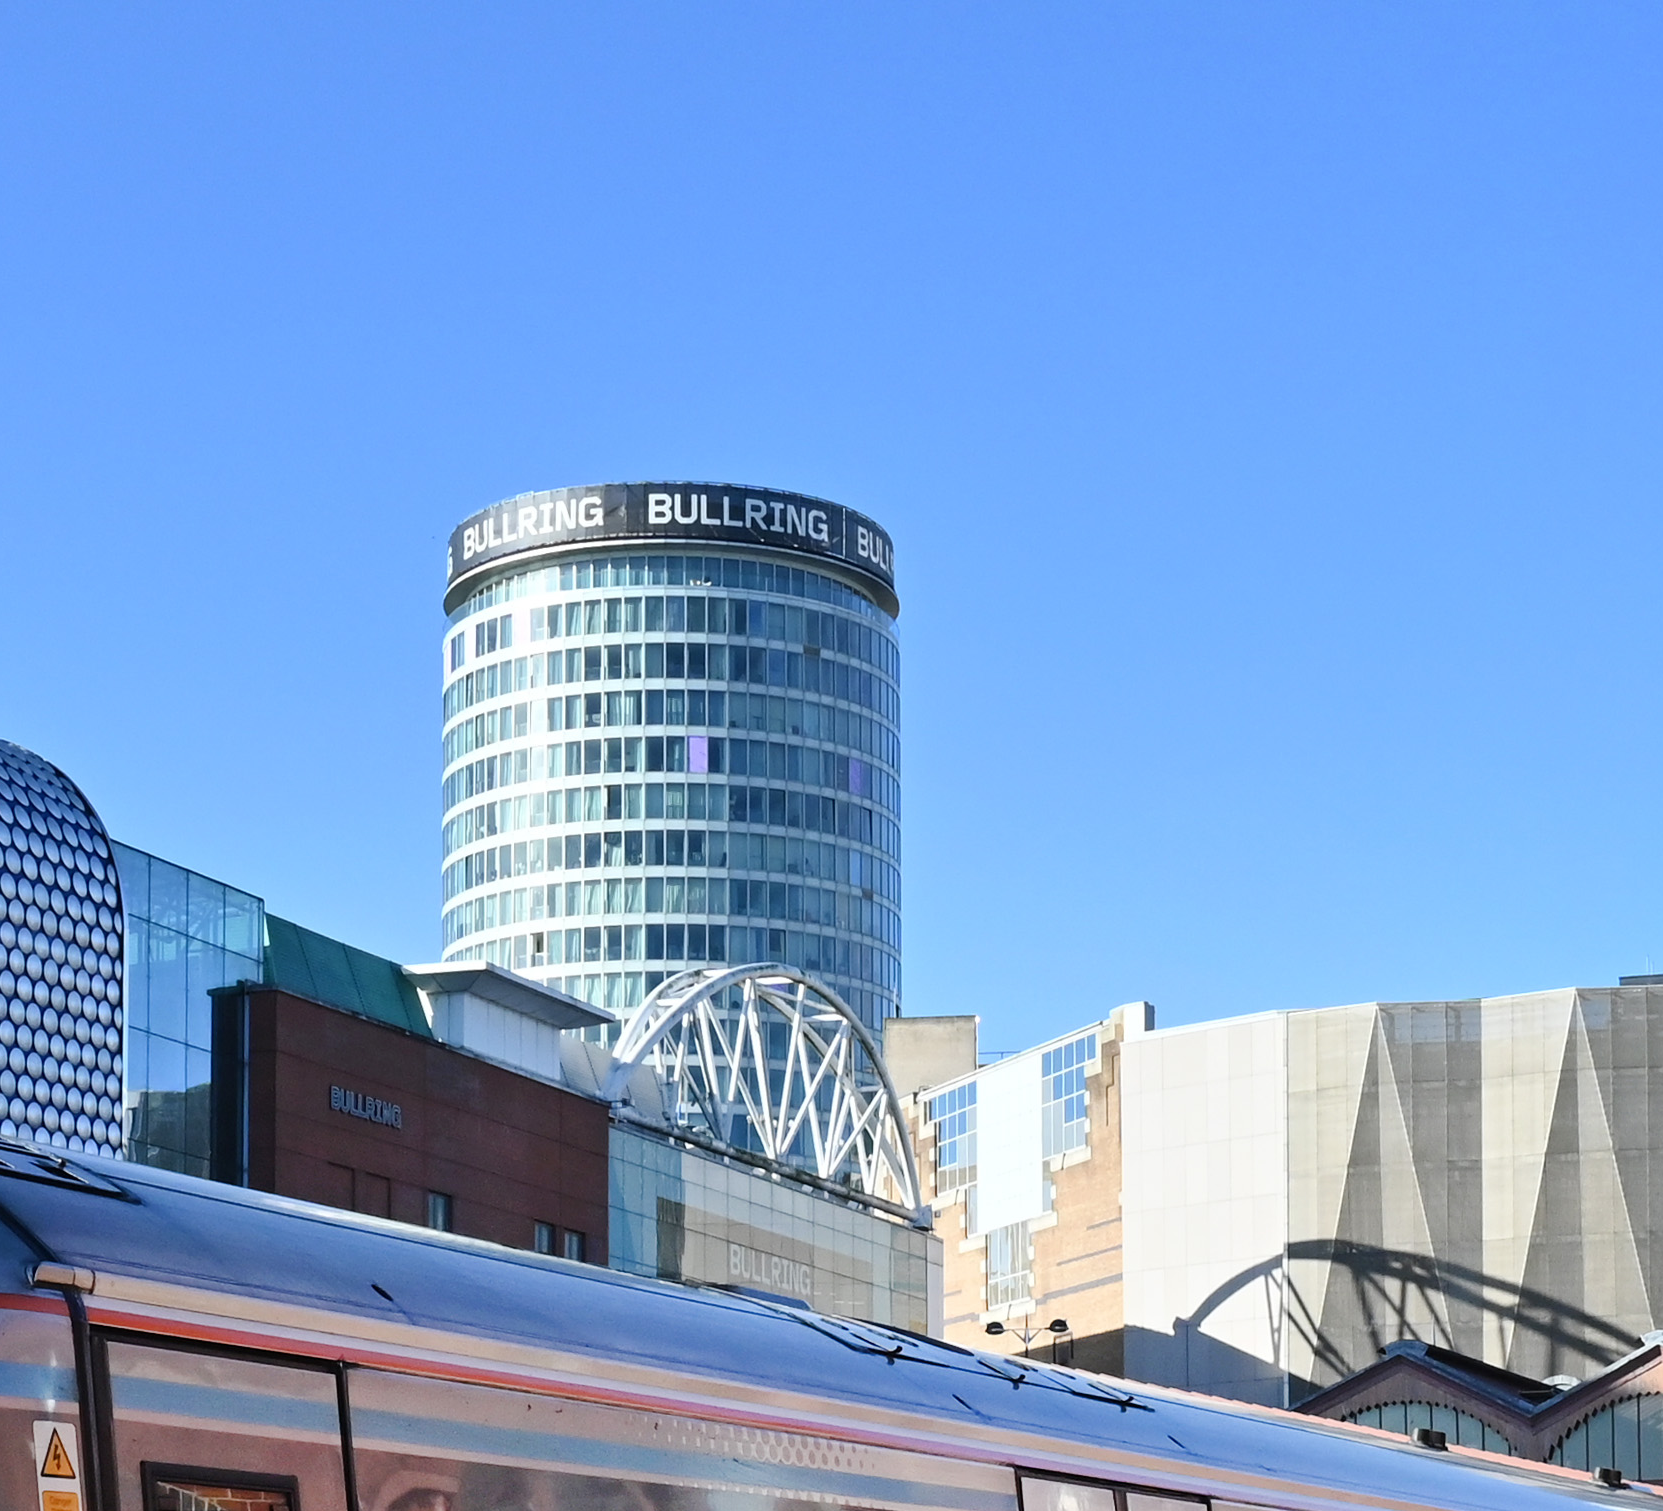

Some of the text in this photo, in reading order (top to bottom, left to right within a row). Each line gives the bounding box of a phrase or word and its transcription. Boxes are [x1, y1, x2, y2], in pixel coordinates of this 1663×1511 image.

[463, 496, 604, 561] BULLRING
[648, 493, 829, 542] BULLRING
[331, 1085, 401, 1129] BULLRING
[729, 1243, 812, 1296] BULLRING
